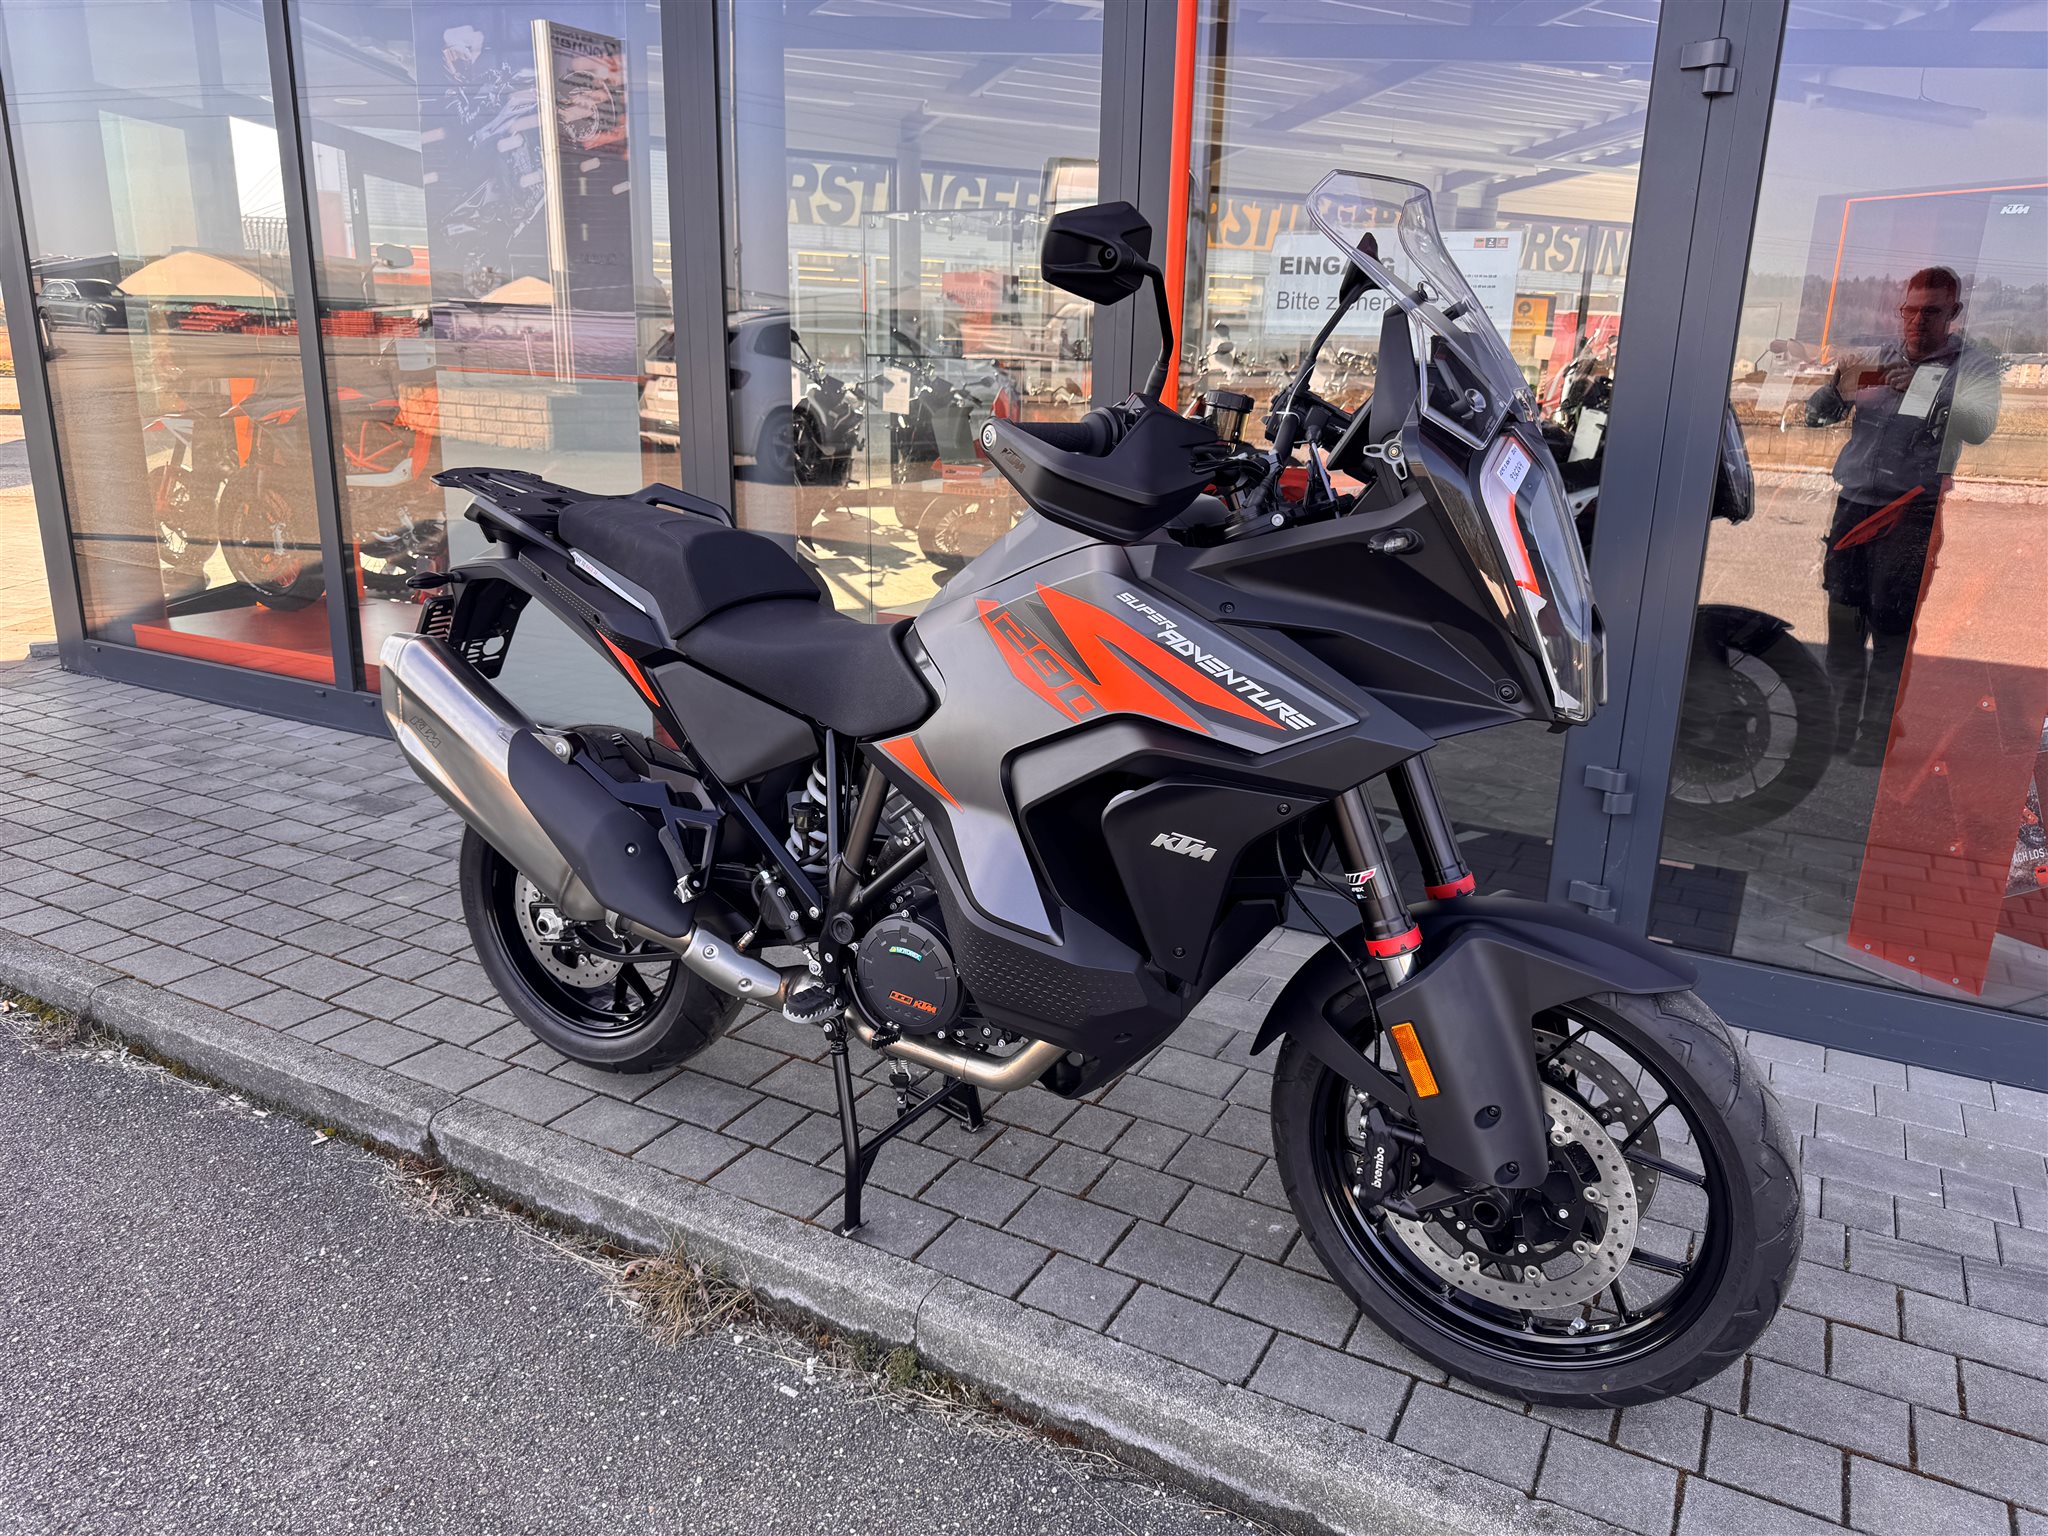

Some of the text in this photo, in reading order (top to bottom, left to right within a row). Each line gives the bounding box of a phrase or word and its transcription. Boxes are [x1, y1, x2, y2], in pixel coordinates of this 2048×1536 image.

[2000, 204, 2030, 214] KTM
[1280, 256, 1395, 276] EINGG
[1276, 291, 1319, 310] Bitte
[1116, 592, 1178, 630] SUPER
[984, 606, 1107, 722] 1290
[1157, 629, 1317, 731] ADVENTURE
[1150, 832, 1218, 862] KTM
[2029, 847, 2046, 860] LOS
[913, 1000, 937, 1015] KTM
[1371, 1146, 1385, 1189] brembo
